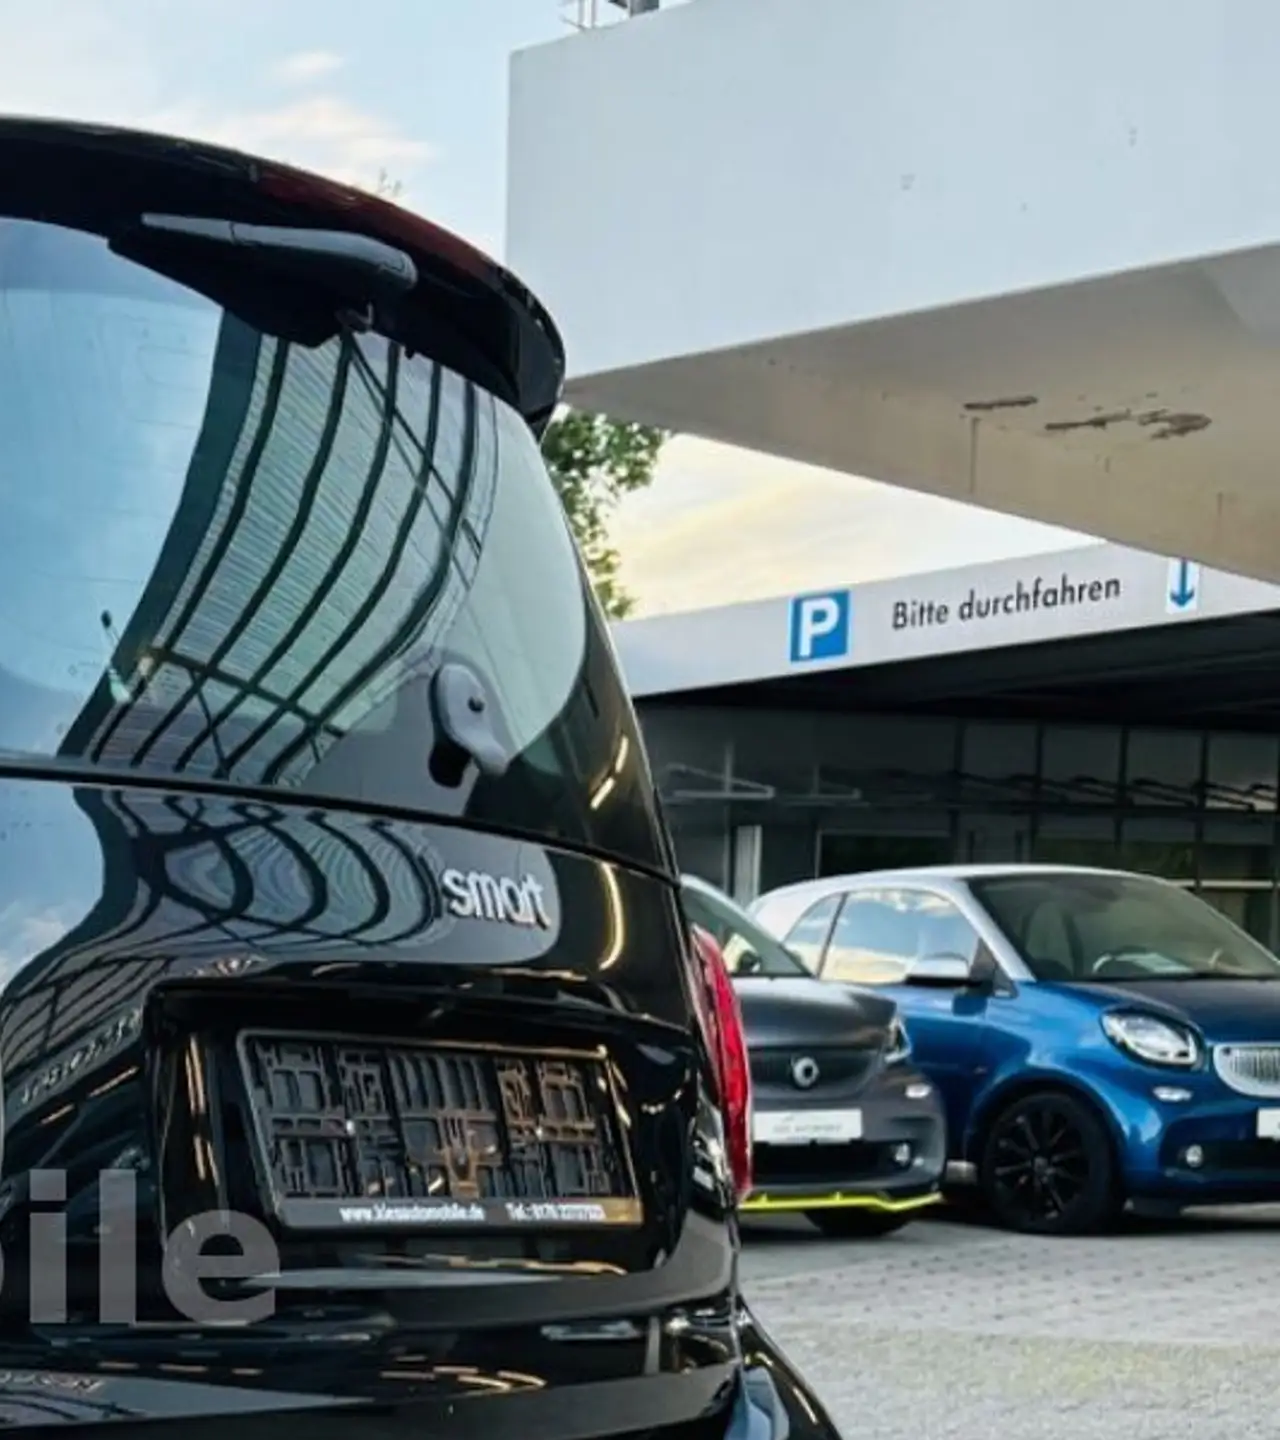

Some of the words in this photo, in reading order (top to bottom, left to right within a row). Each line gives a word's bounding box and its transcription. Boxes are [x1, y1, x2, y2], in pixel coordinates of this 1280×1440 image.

[892, 600, 951, 630] Bitte
[958, 576, 1121, 620] durchfahren
[442, 867, 552, 927] smart
